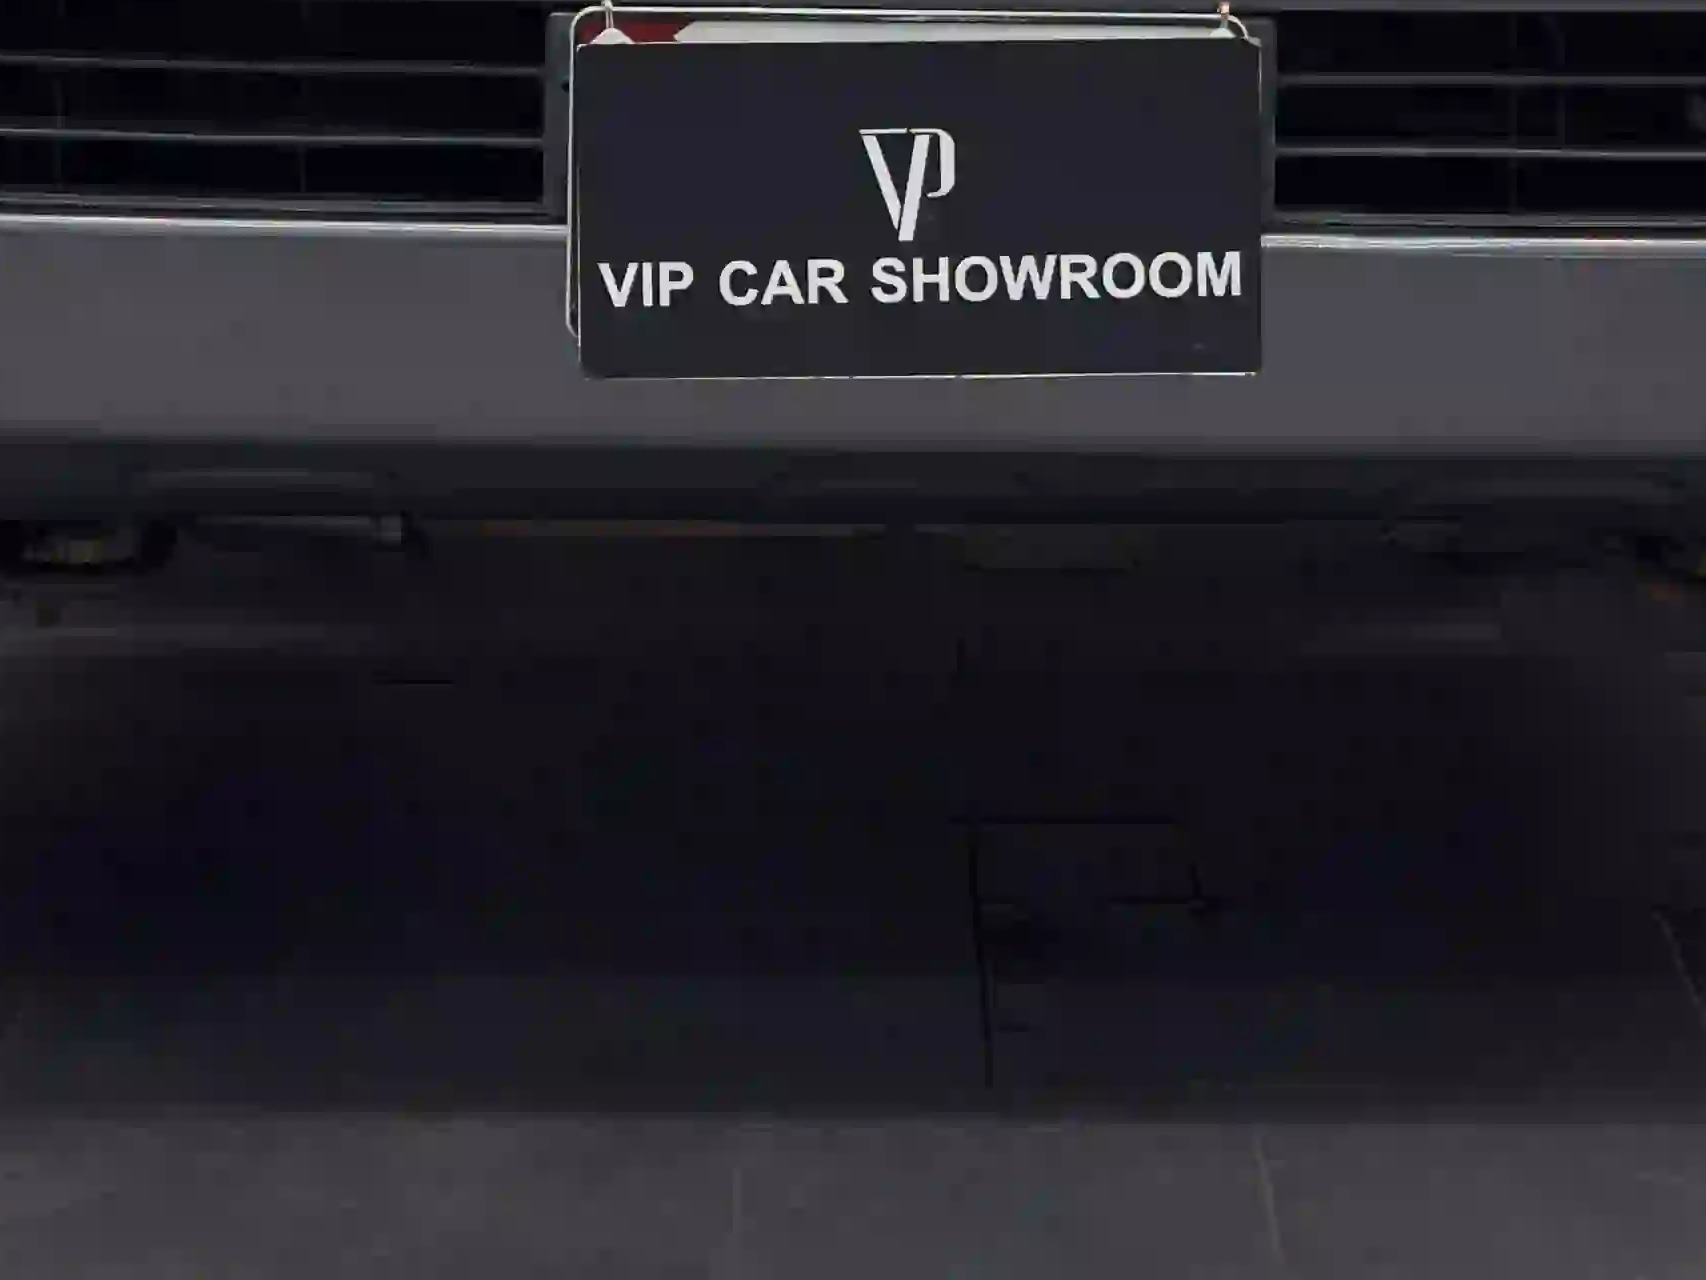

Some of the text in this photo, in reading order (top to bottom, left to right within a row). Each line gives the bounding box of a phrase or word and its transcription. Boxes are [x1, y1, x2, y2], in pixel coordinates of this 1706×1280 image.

[597, 250, 1243, 308] VIP CAR SHOWROOM
